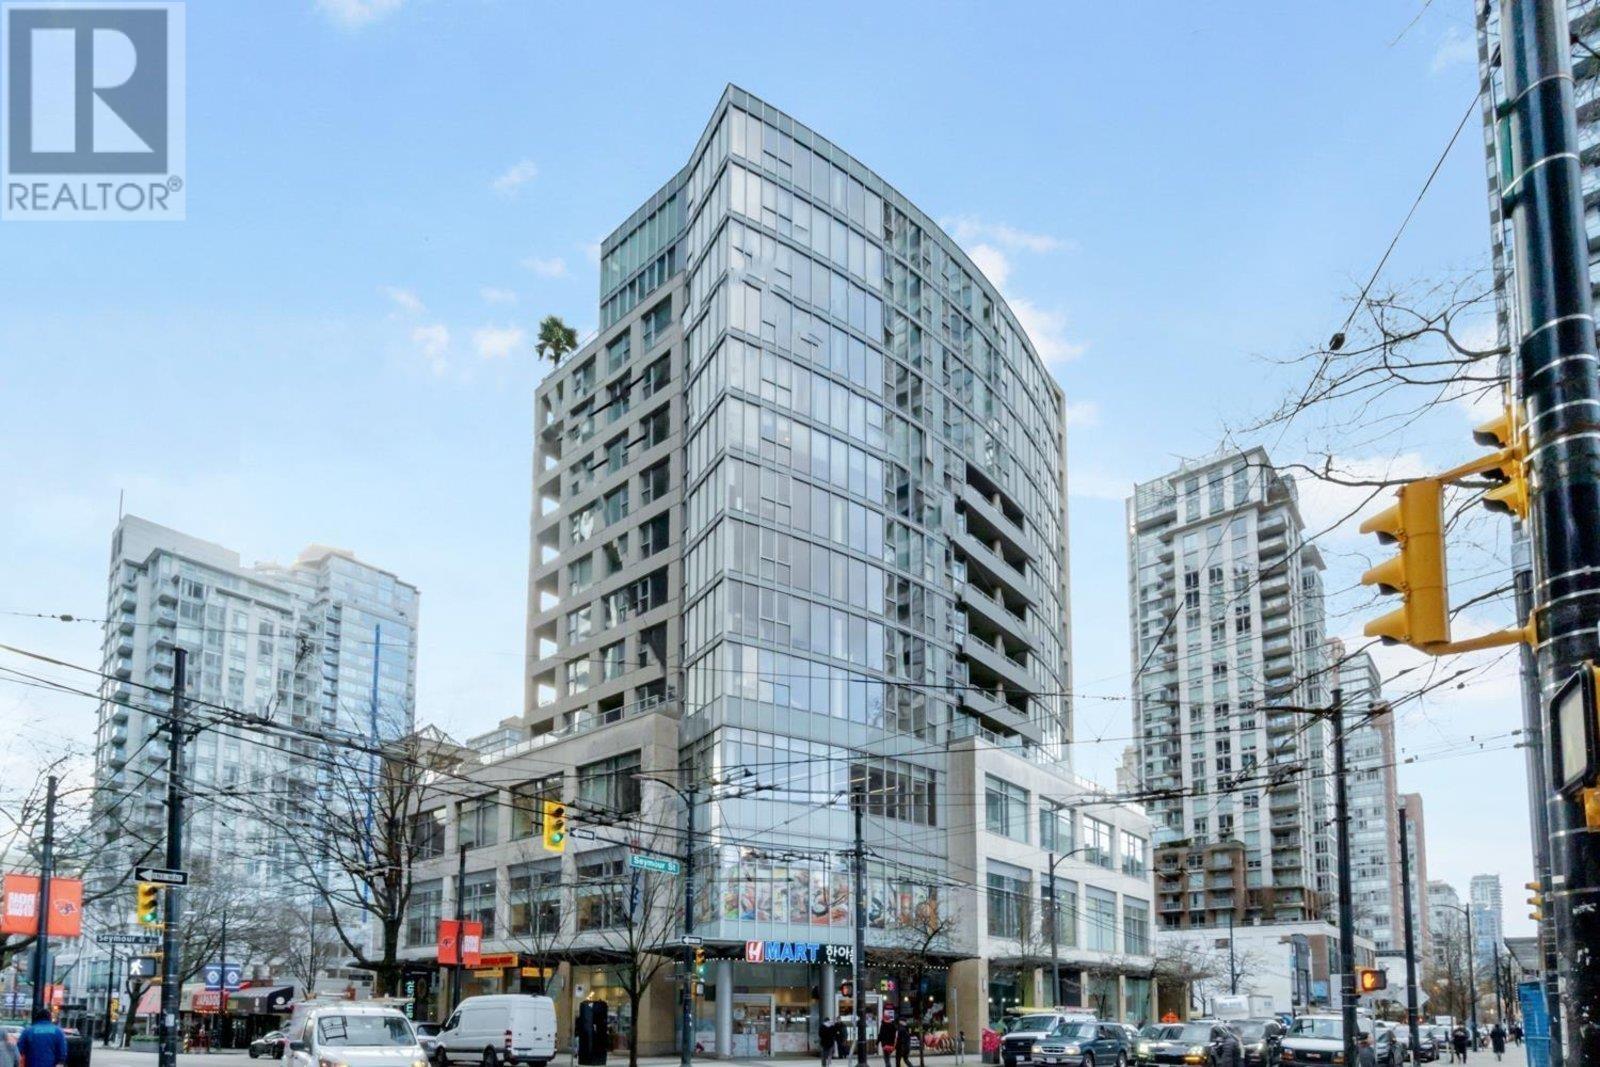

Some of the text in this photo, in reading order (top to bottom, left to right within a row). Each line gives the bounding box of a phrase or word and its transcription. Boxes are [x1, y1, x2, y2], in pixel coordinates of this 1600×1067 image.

[633, 856, 676, 871] Seymour St
[98, 935, 136, 943] Seymour
[747, 940, 819, 961] H MART
